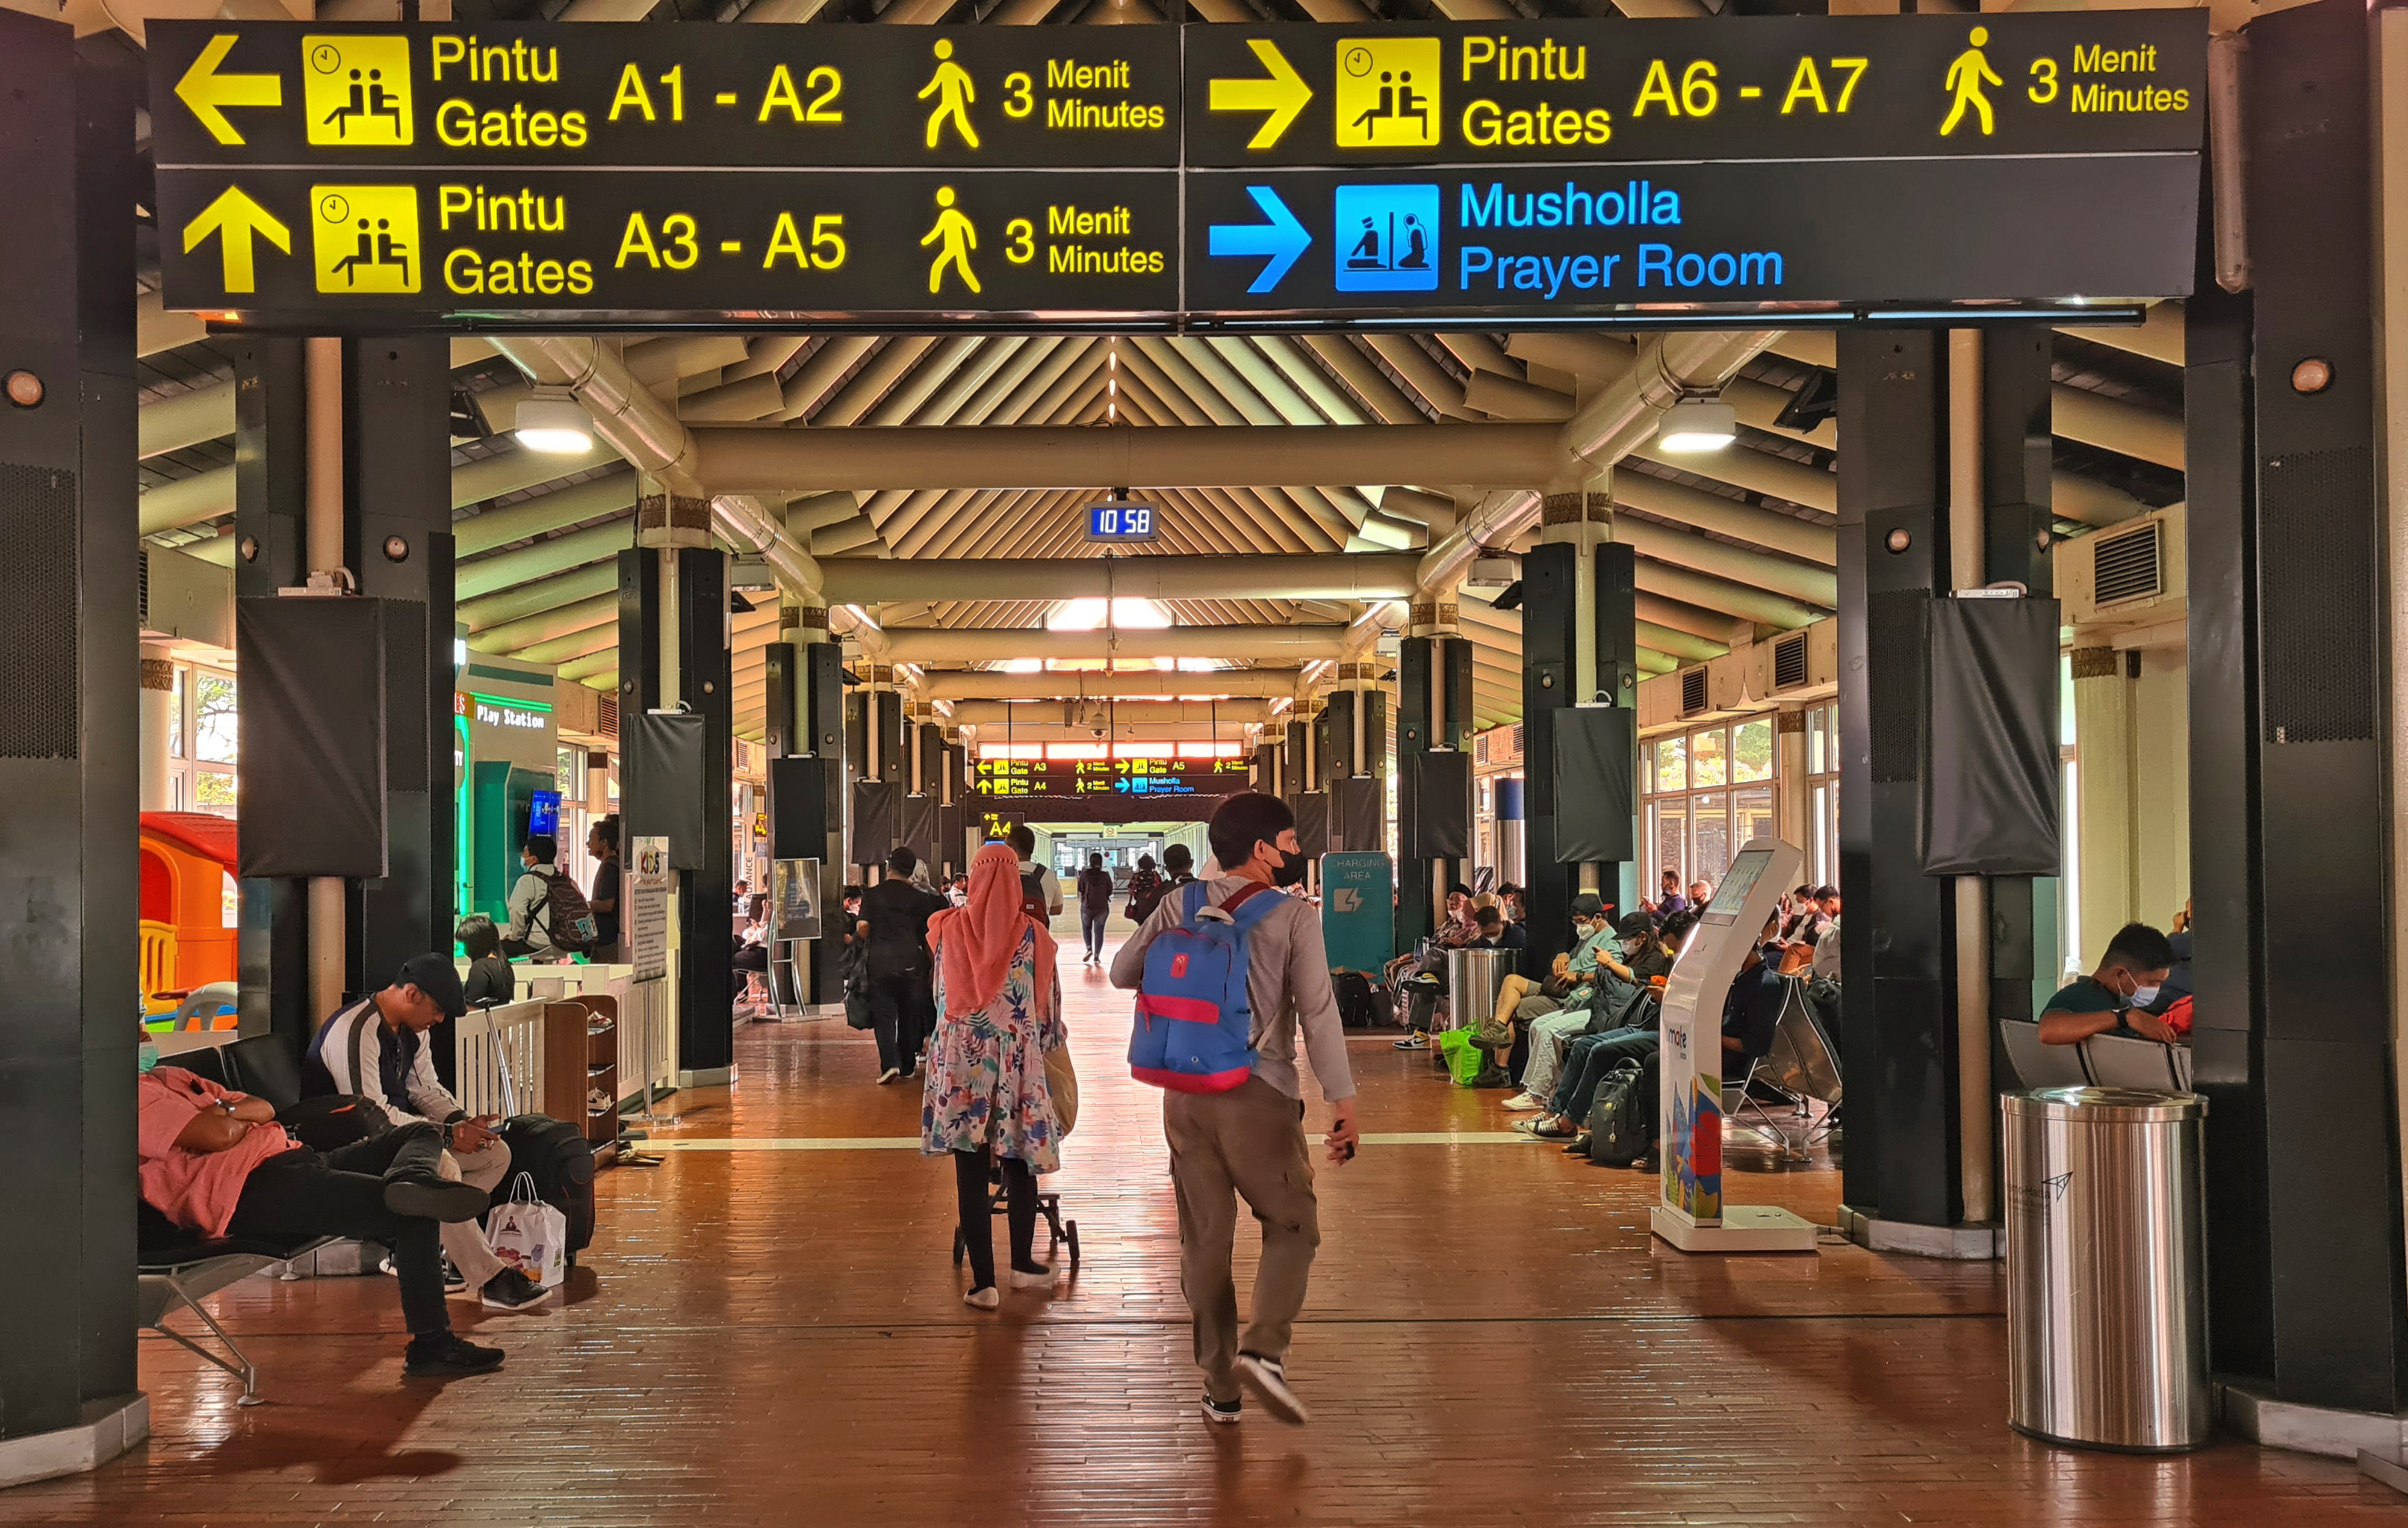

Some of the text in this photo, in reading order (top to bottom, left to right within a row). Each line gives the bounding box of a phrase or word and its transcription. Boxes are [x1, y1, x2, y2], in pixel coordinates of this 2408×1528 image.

[433, 36, 557, 82] Pintu
[1048, 60, 1129, 88] Menit
[1463, 36, 1585, 81] Pintu
[2074, 45, 2156, 72] Menit
[609, 64, 842, 122] A1 - A2
[1004, 72, 1033, 117] 3
[1633, 57, 1868, 117] A6 - A7
[2028, 58, 2058, 103] 3
[2071, 84, 2188, 112] Minutes
[436, 99, 587, 147] Gates
[1048, 99, 1164, 128] Minutes
[1463, 100, 1610, 146] Gates
[439, 185, 564, 231] Pintu
[1049, 206, 1130, 234] Menit
[1462, 181, 1681, 227] Musholla
[615, 212, 845, 269] A3 - A5
[1006, 219, 1034, 263] 3
[444, 249, 593, 294] Gates
[1050, 246, 1164, 273] Minutes
[1461, 244, 1782, 299] Prayer Room
[1100, 510, 1150, 533] 10 58
[477, 705, 545, 729] Play Station
[1034, 762, 1047, 772] A3
[1173, 761, 1185, 770] A5
[1034, 782, 1047, 790] A4
[990, 821, 1011, 836] A4
[641, 851, 660, 874] KIDS
[1330, 859, 1385, 867] HARGING
